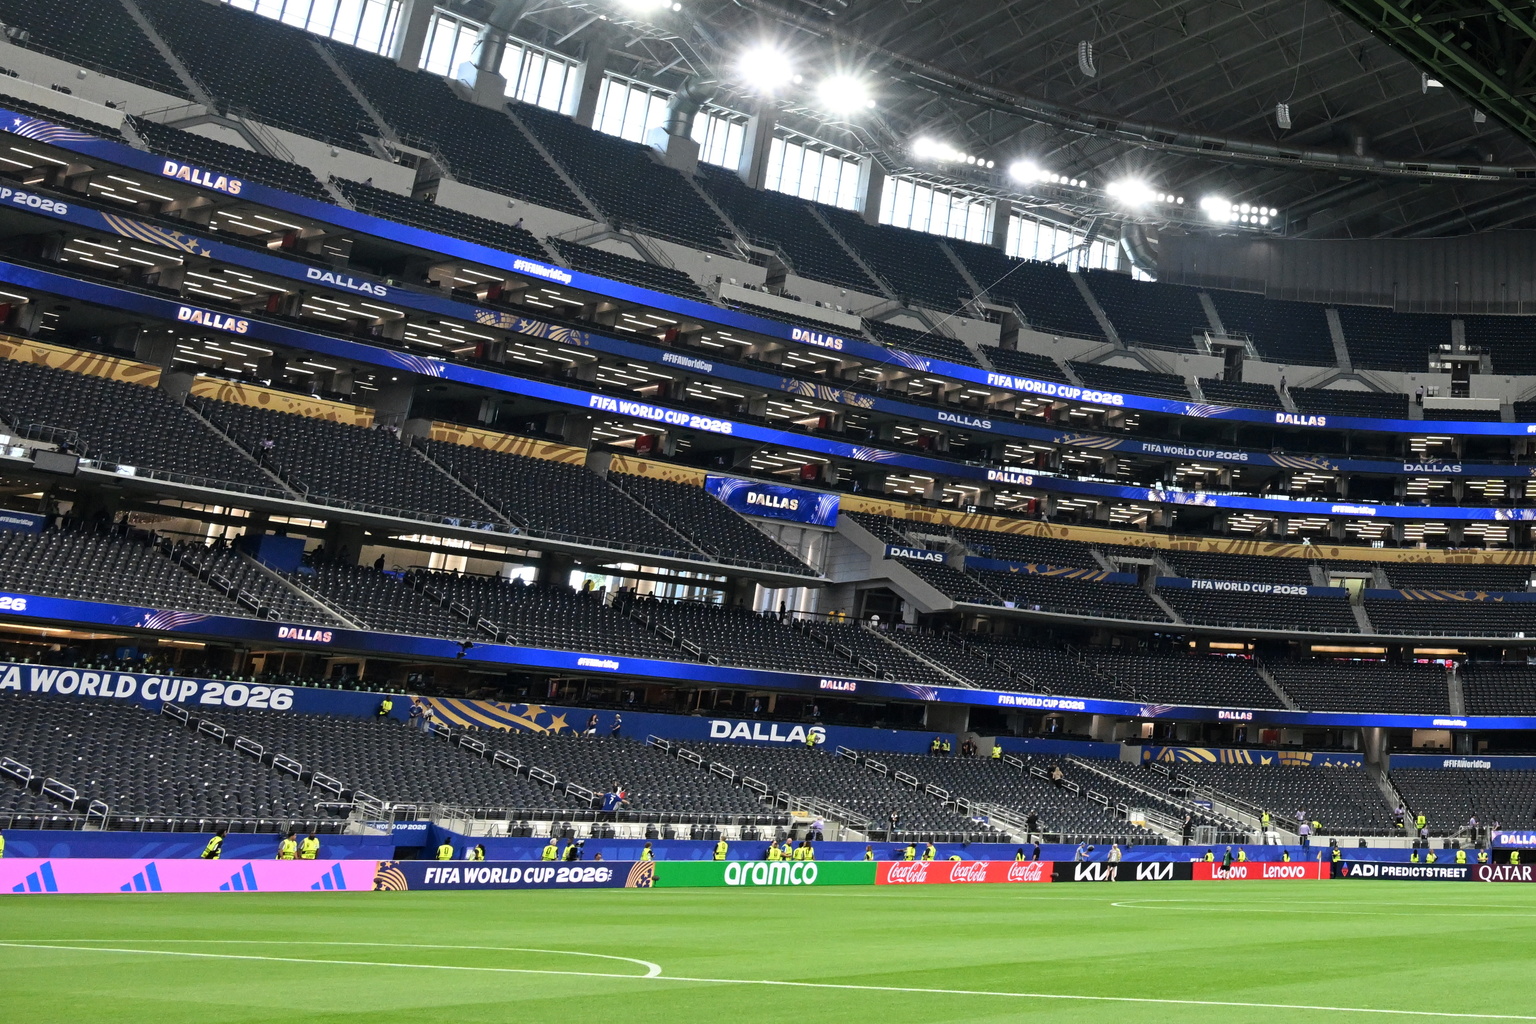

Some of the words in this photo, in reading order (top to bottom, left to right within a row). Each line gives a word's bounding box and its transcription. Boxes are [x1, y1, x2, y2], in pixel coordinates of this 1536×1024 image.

[162, 160, 242, 195] DALLAS
[13, 192, 68, 215] 2026
[306, 267, 387, 297] DALLAS
[177, 306, 249, 334] DALLAS
[792, 328, 843, 351] DALLAS
[662, 352, 713, 372] #FIFAWorldCup
[988, 374, 1013, 388] FIFA
[1014, 377, 1056, 394] WORLD
[1058, 384, 1081, 398] CUP
[1082, 390, 1123, 405] 2026
[590, 395, 617, 412] FIFA
[619, 401, 664, 423] WORLD
[665, 410, 689, 426] CUP
[689, 415, 732, 434] 2026
[938, 412, 992, 429] DALLAS
[1276, 412, 1326, 426] DALLAS
[1142, 443, 1162, 454] FIFA
[1163, 445, 1195, 457] WORLD
[1196, 448, 1214, 458] CUP
[1216, 450, 1248, 461] 2026
[1403, 463, 1462, 473] DALLAS
[988, 470, 1032, 486] DALLAS
[747, 492, 799, 511] DALLAS
[890, 547, 943, 563] DALLAS
[1192, 580, 1212, 590] FIFA
[1214, 582, 1250, 593] WORLD
[1251, 584, 1272, 594] CUP
[1273, 585, 1307, 595] 2026
[278, 626, 332, 643] DALLAS
[30, 668, 137, 698] WORLD
[141, 678, 198, 702] CUP
[200, 683, 294, 710] 2026
[820, 679, 856, 691] DALLAS
[1218, 711, 1252, 720] DALLAS
[710, 720, 826, 744] DALLAS
[1443, 758, 1491, 769] #FIFAWorldCup
[424, 867, 460, 884] FIFA
[464, 867, 522, 884] WORLD
[523, 867, 554, 883] CUP
[556, 867, 609, 883] 2026
[724, 862, 818, 885] aramco
[888, 862, 930, 883] Coca-Cola
[950, 862, 989, 882] Coca-Cola
[1008, 862, 1045, 881] Coca-Cola
[1263, 863, 1305, 878] Lenovo
[1351, 864, 1378, 875] ADI
[1381, 866, 1467, 878] PREDICTSTREET
[1479, 865, 1532, 882] QATAR
